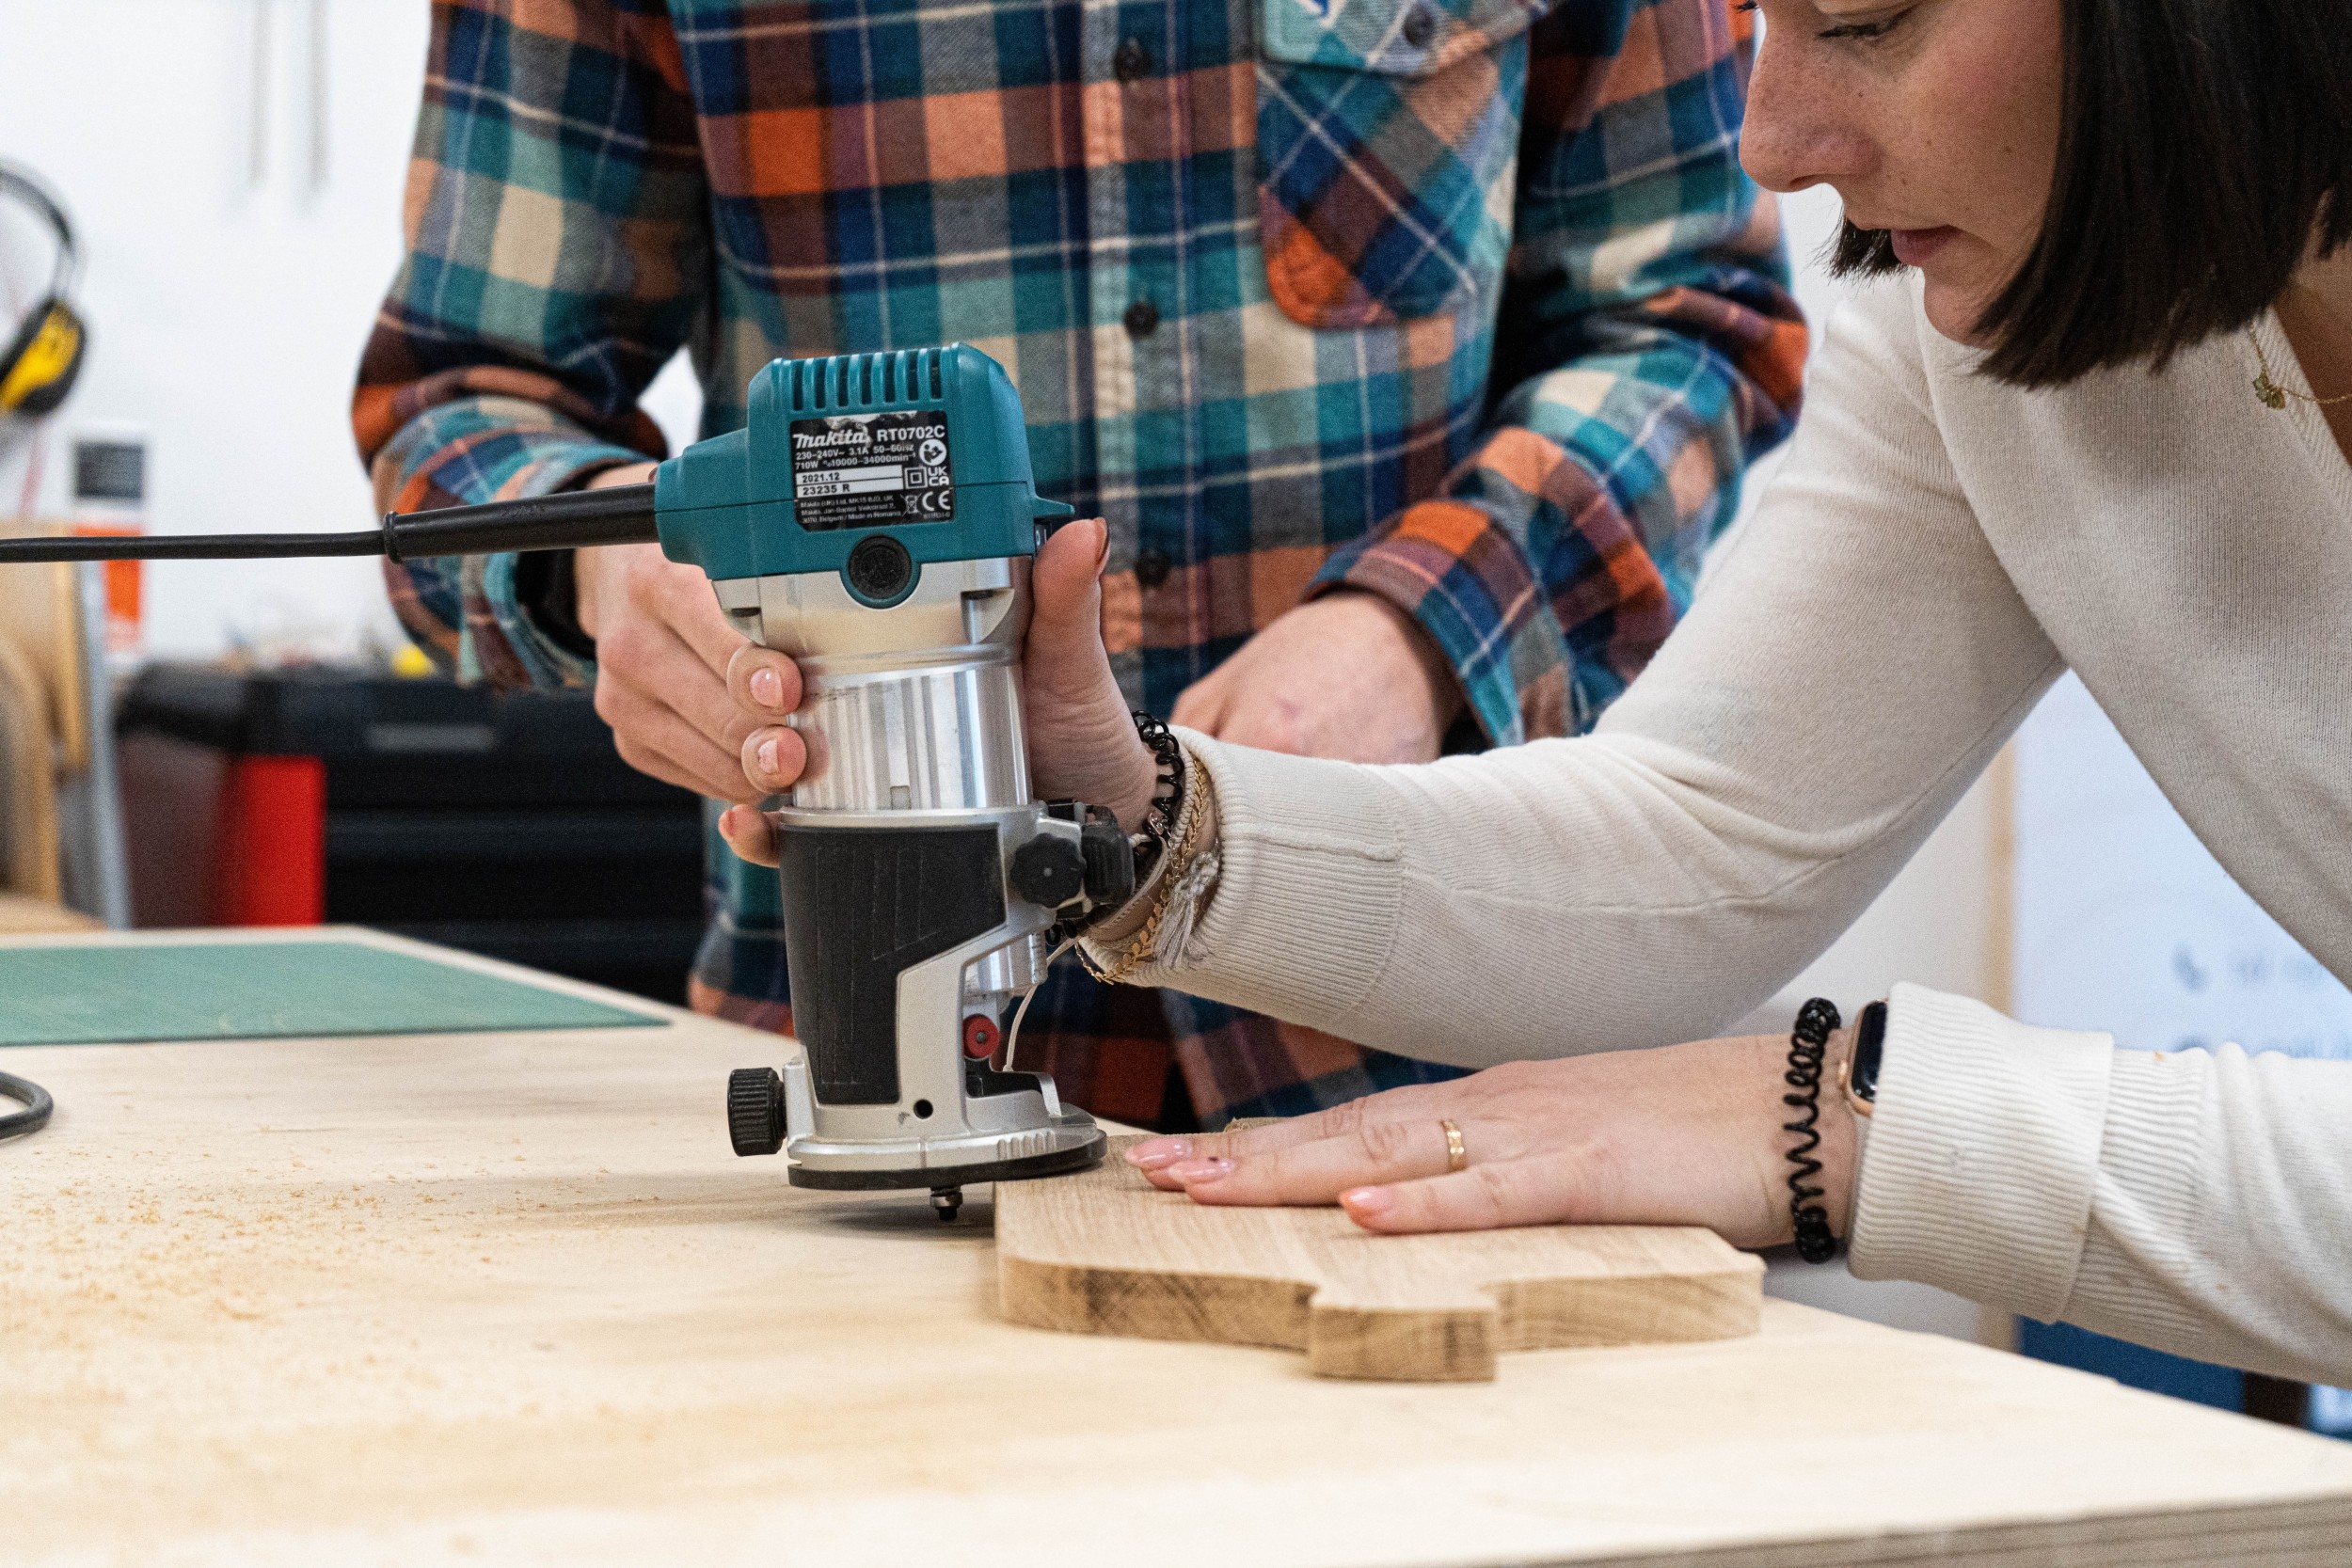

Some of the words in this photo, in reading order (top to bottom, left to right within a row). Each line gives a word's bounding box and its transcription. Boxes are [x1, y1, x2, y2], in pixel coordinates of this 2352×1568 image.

[876, 424, 946, 442] RT0702C
[849, 447, 869, 456] 3.1A
[795, 460, 818, 470] 710W
[802, 471, 840, 483] 2021.12
[928, 466, 947, 477] UK
[929, 476, 950, 486] CA
[803, 485, 837, 496] 23235
[842, 483, 850, 493] R
[922, 490, 952, 512] CE
